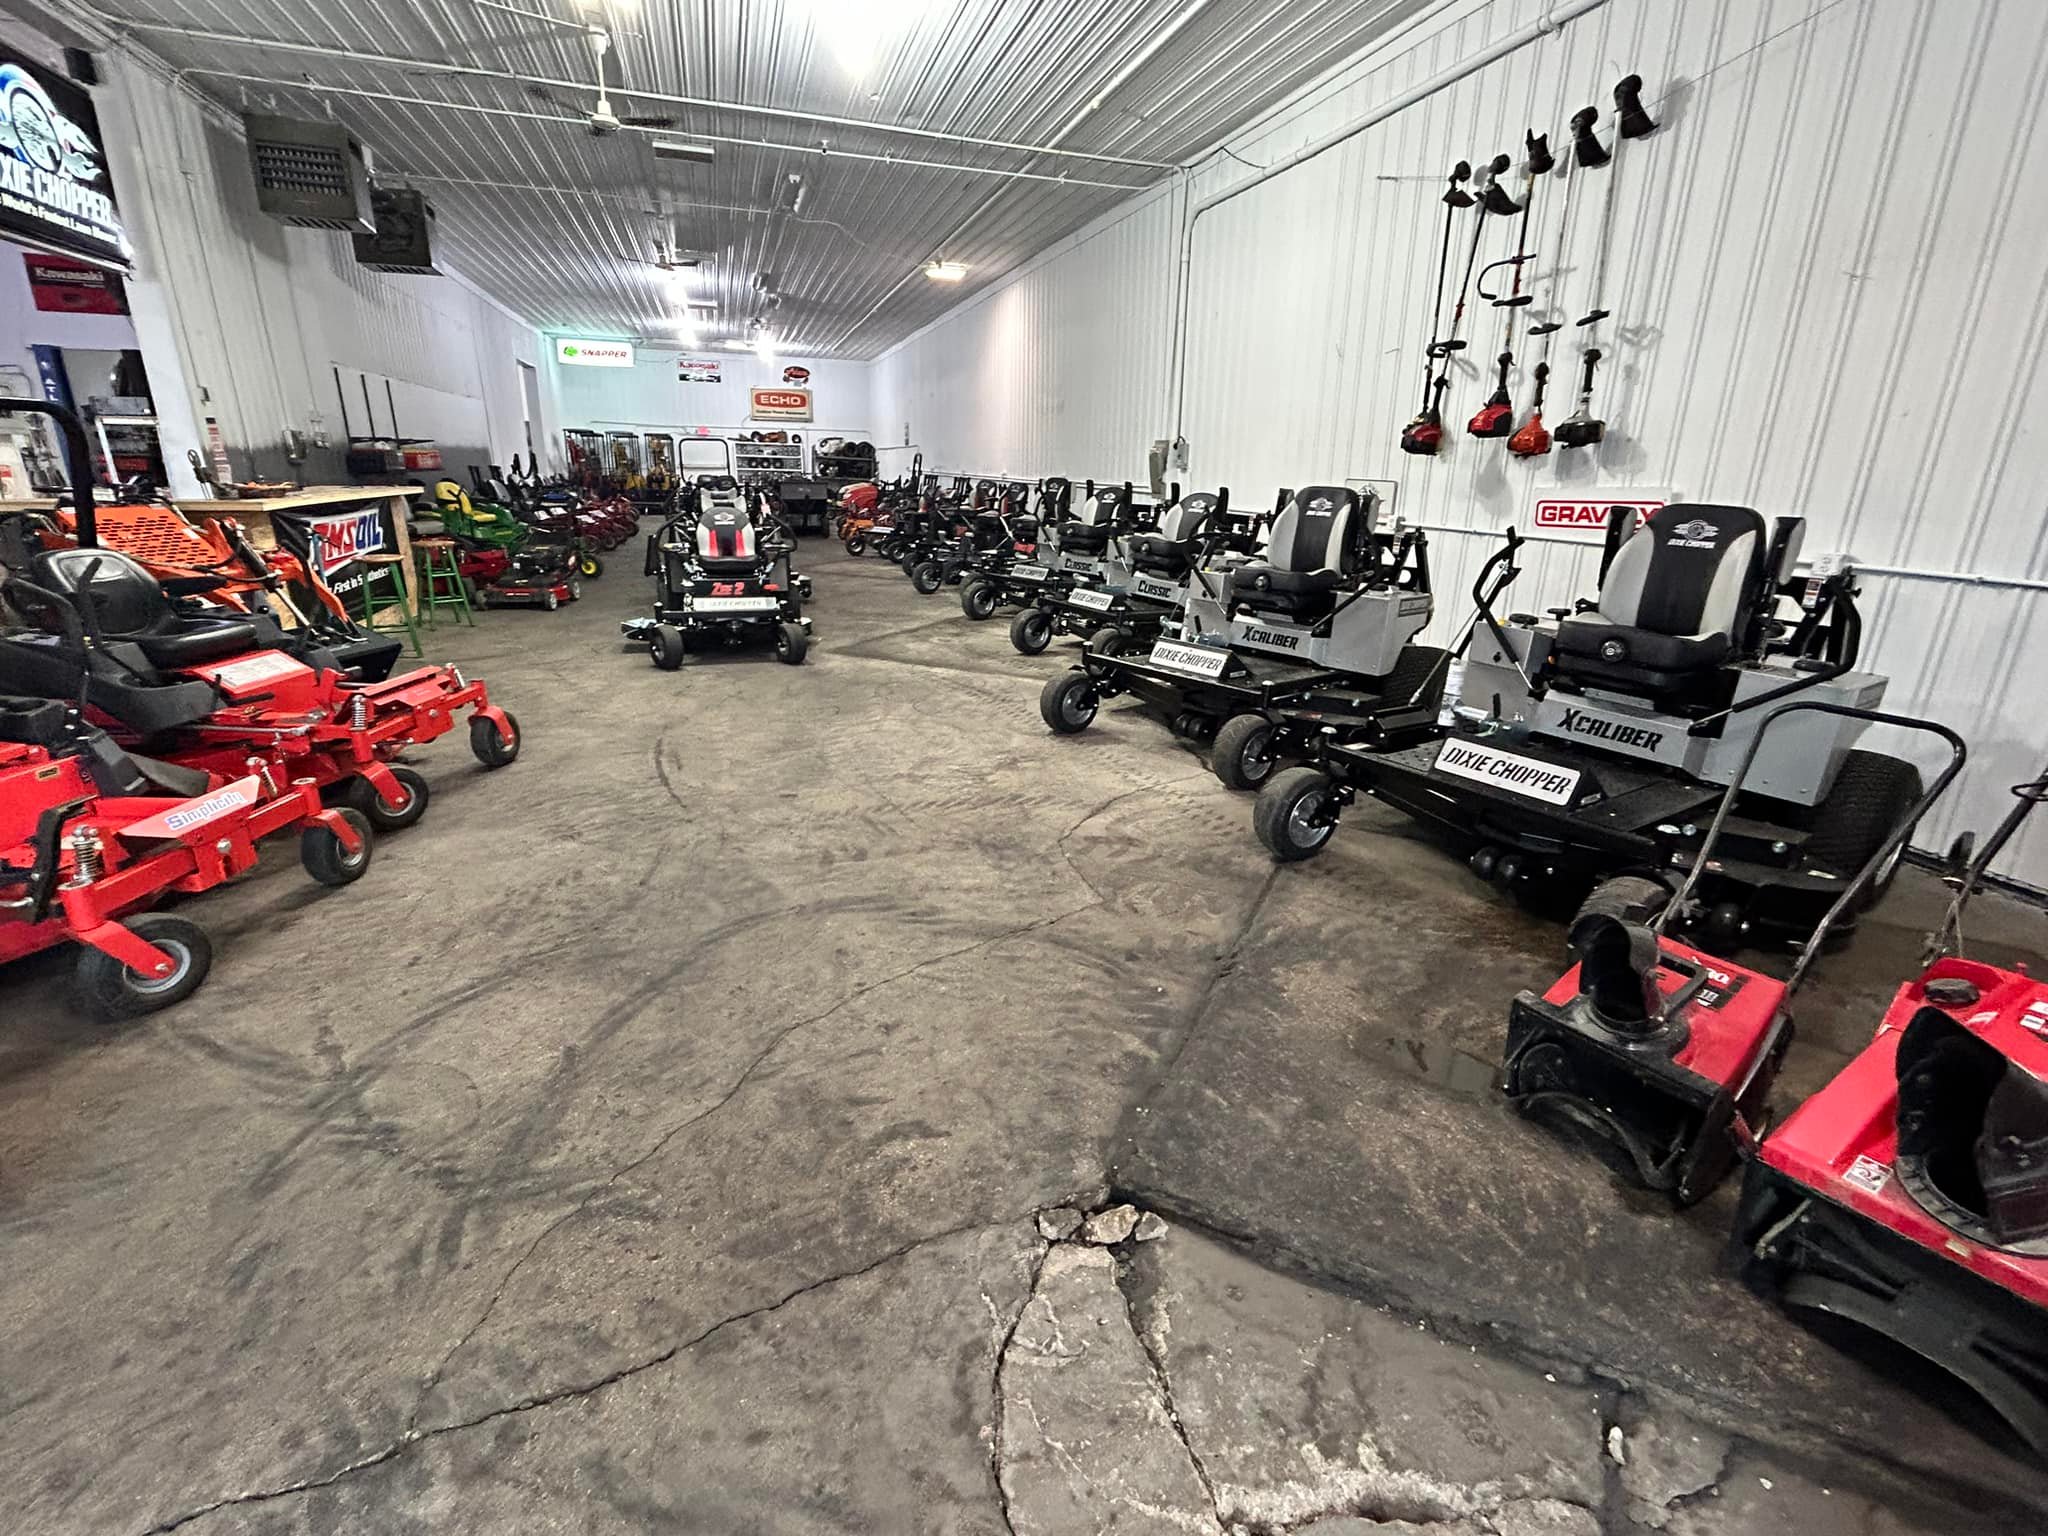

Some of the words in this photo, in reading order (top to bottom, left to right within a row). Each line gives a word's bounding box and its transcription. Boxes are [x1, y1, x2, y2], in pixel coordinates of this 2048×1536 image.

[33, 166, 112, 225] CHOPPER
[582, 349, 627, 358] SNAPPER
[760, 395, 801, 406] ECHO
[1541, 506, 1660, 525] GRAVY
[734, 582, 745, 596] 2
[1242, 626, 1299, 650] XCALIBER
[1154, 647, 1180, 663] DIXIE
[1178, 652, 1223, 671] CHOPPER
[1557, 707, 1663, 752] XCALIBER
[1443, 747, 1491, 772] DIXIE
[1488, 759, 1571, 795] CHOPPER
[166, 791, 246, 829] Simplicity
